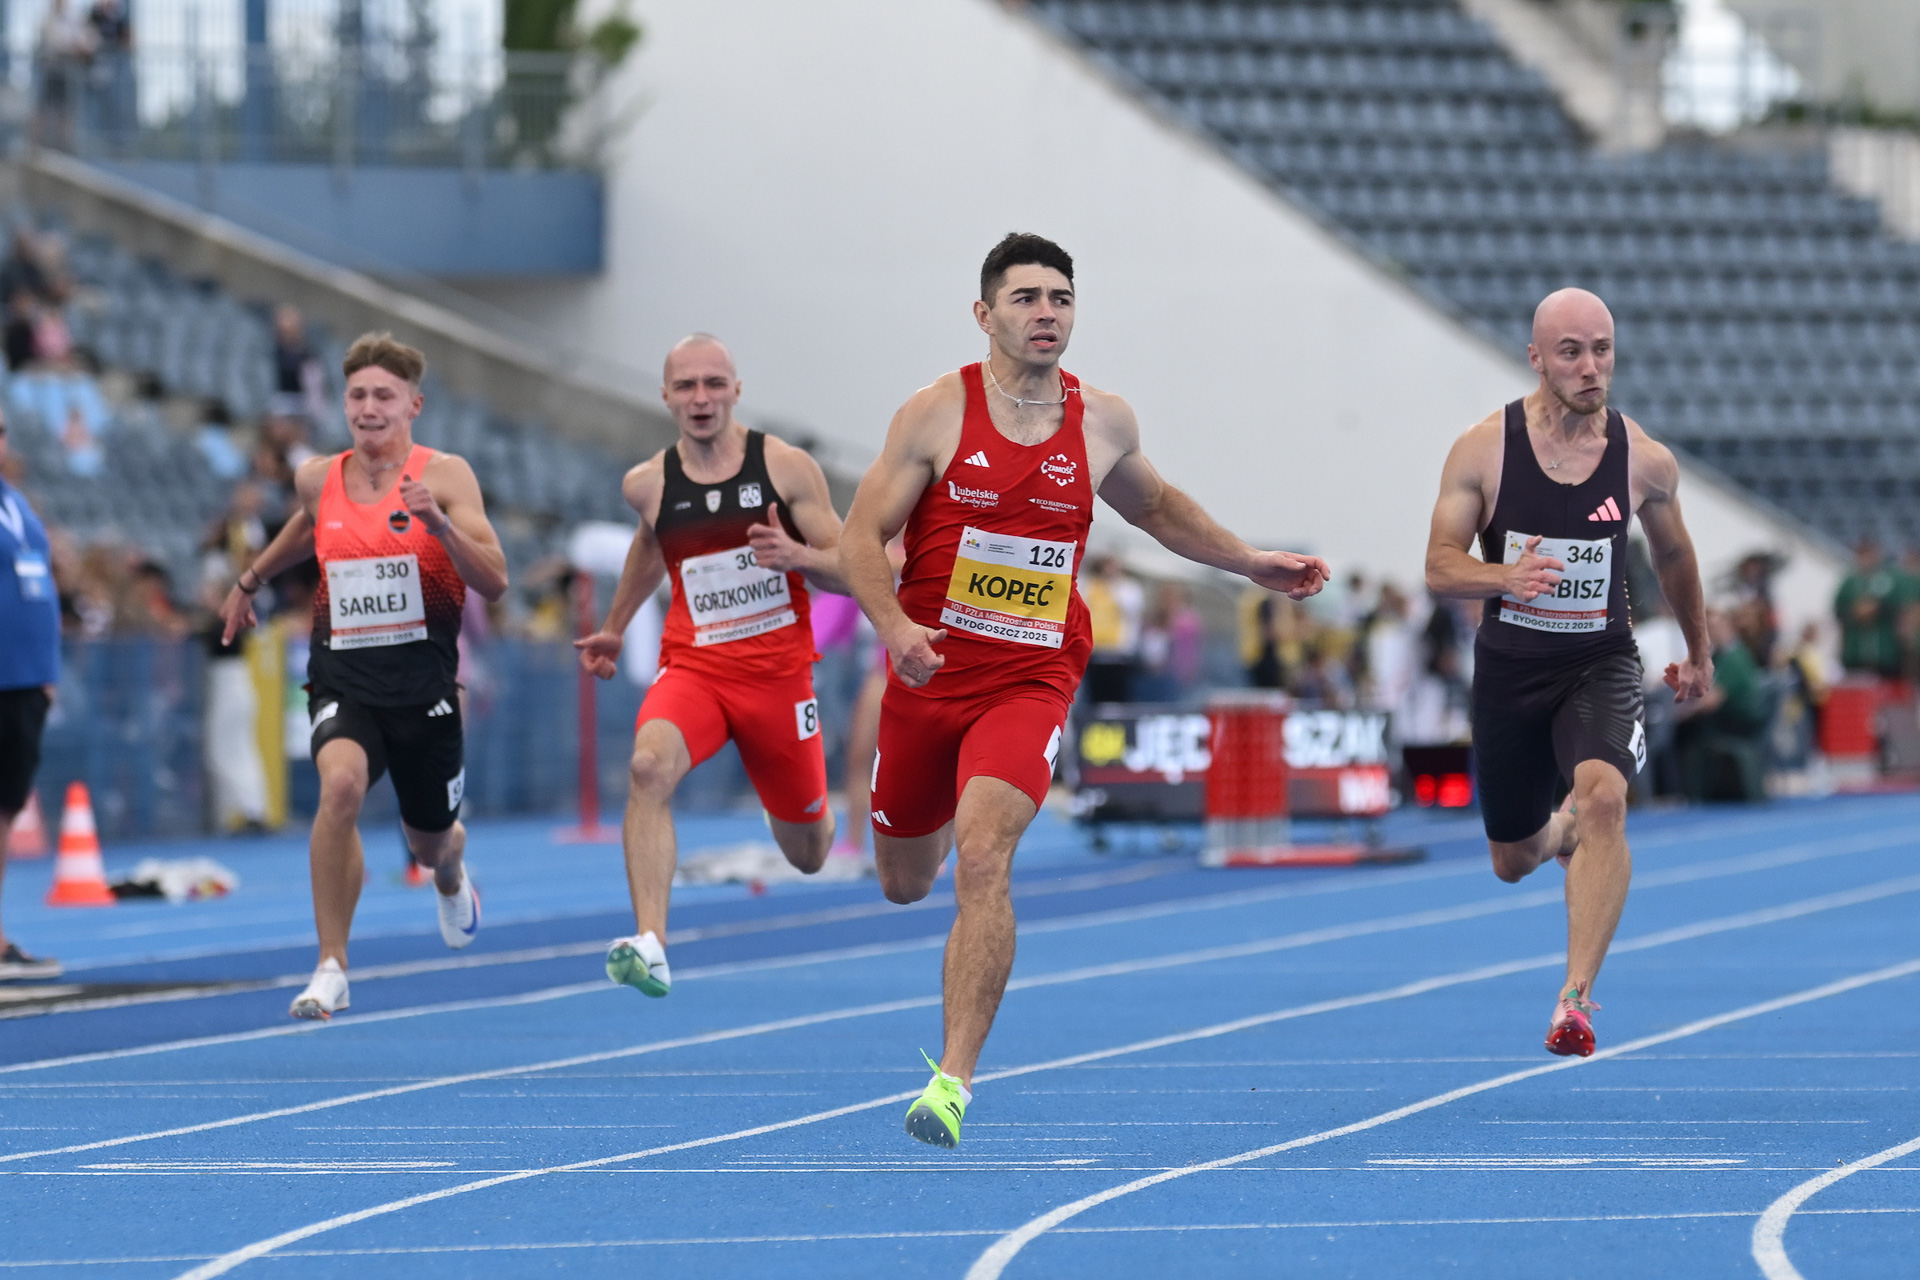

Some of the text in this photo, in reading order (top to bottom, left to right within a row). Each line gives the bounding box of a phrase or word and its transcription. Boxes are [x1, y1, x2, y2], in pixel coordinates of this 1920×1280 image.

[948, 480, 999, 500] Lubelskie
[1029, 545, 1065, 568] 126
[1567, 546, 1603, 564] 346
[375, 562, 409, 580] 330
[694, 575, 784, 613] GORZKOWICZ
[968, 572, 1054, 606] KOPEĆ
[1551, 579, 1605, 599] BISZ
[340, 593, 407, 616] SARLEJ
[951, 602, 1058, 631] 101. PZLA Mistrzostwa Polski
[1512, 614, 1594, 630] BYDGOSZCZ 2025
[955, 616, 1048, 641] BYDGOSZCZ 2025
[804, 703, 816, 733] 8
[1636, 733, 1645, 762] 6
